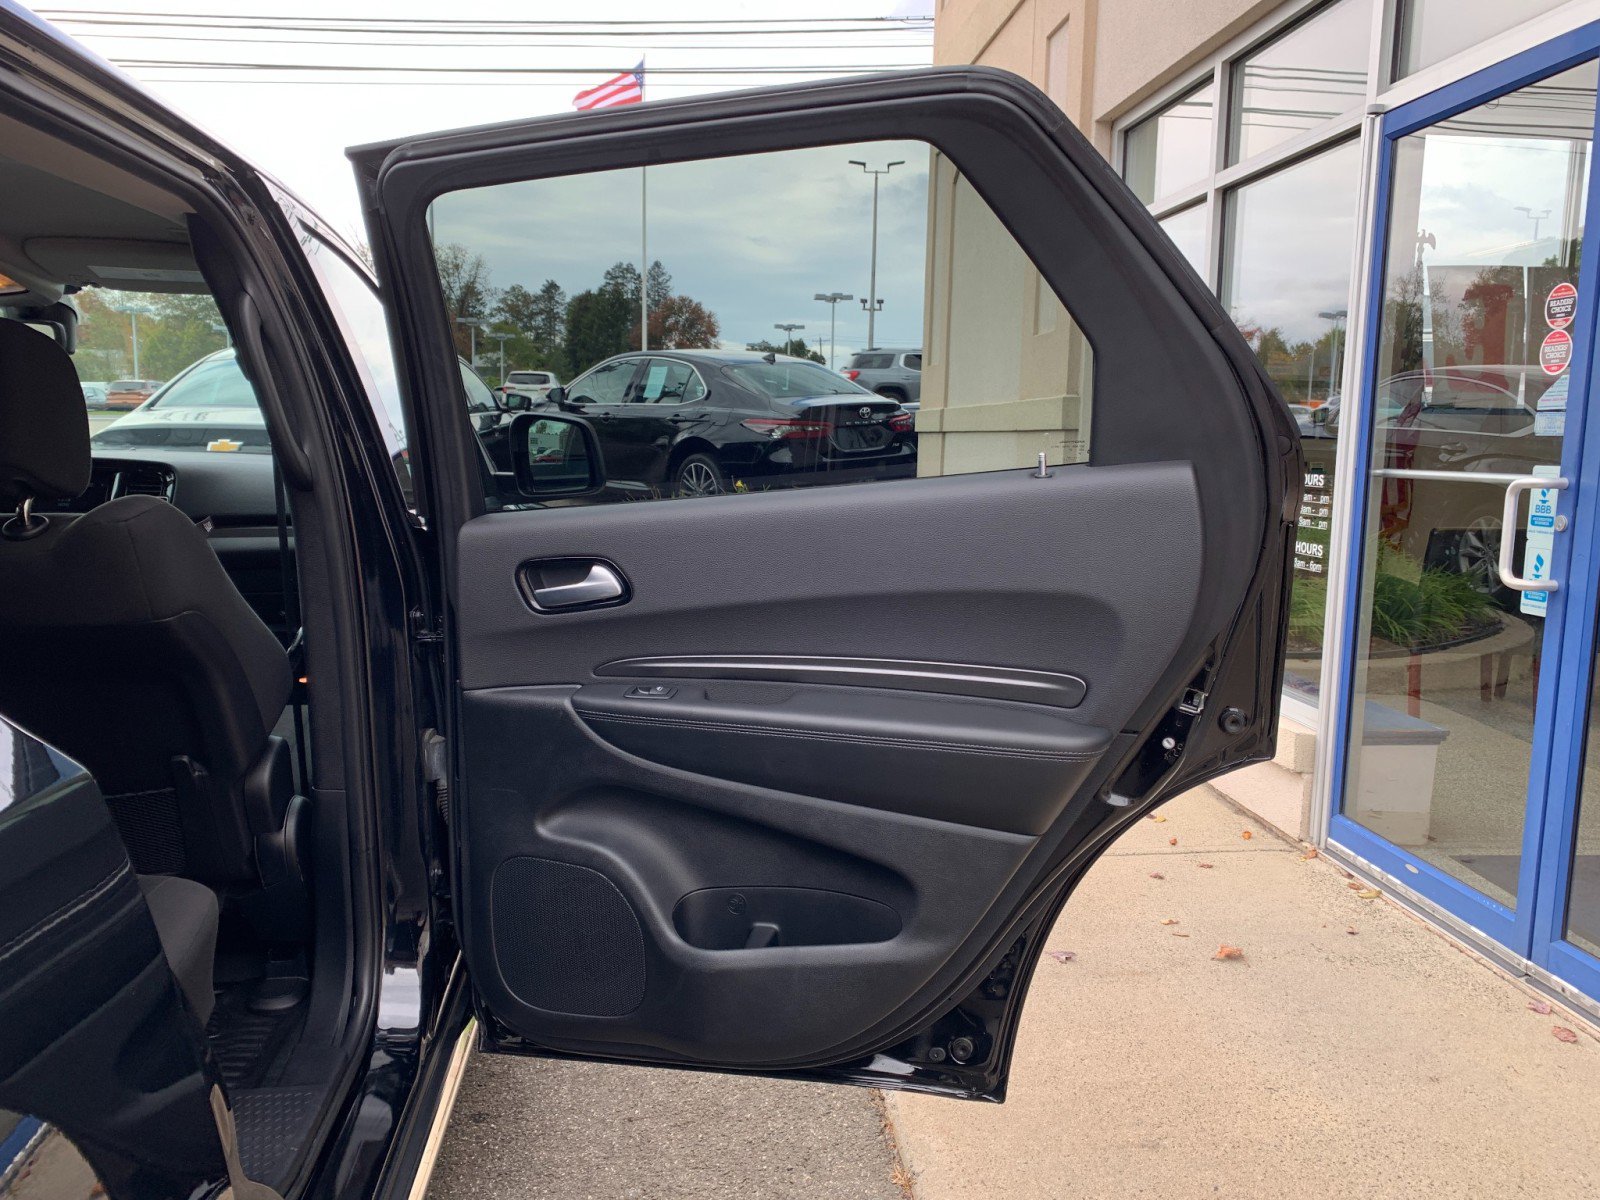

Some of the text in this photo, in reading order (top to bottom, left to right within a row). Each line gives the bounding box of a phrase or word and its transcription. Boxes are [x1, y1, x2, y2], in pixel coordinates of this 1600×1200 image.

[1551, 305, 1572, 314] CHOICE
[1535, 505, 1551, 514] BBB
[1295, 541, 1323, 557] HOURS
